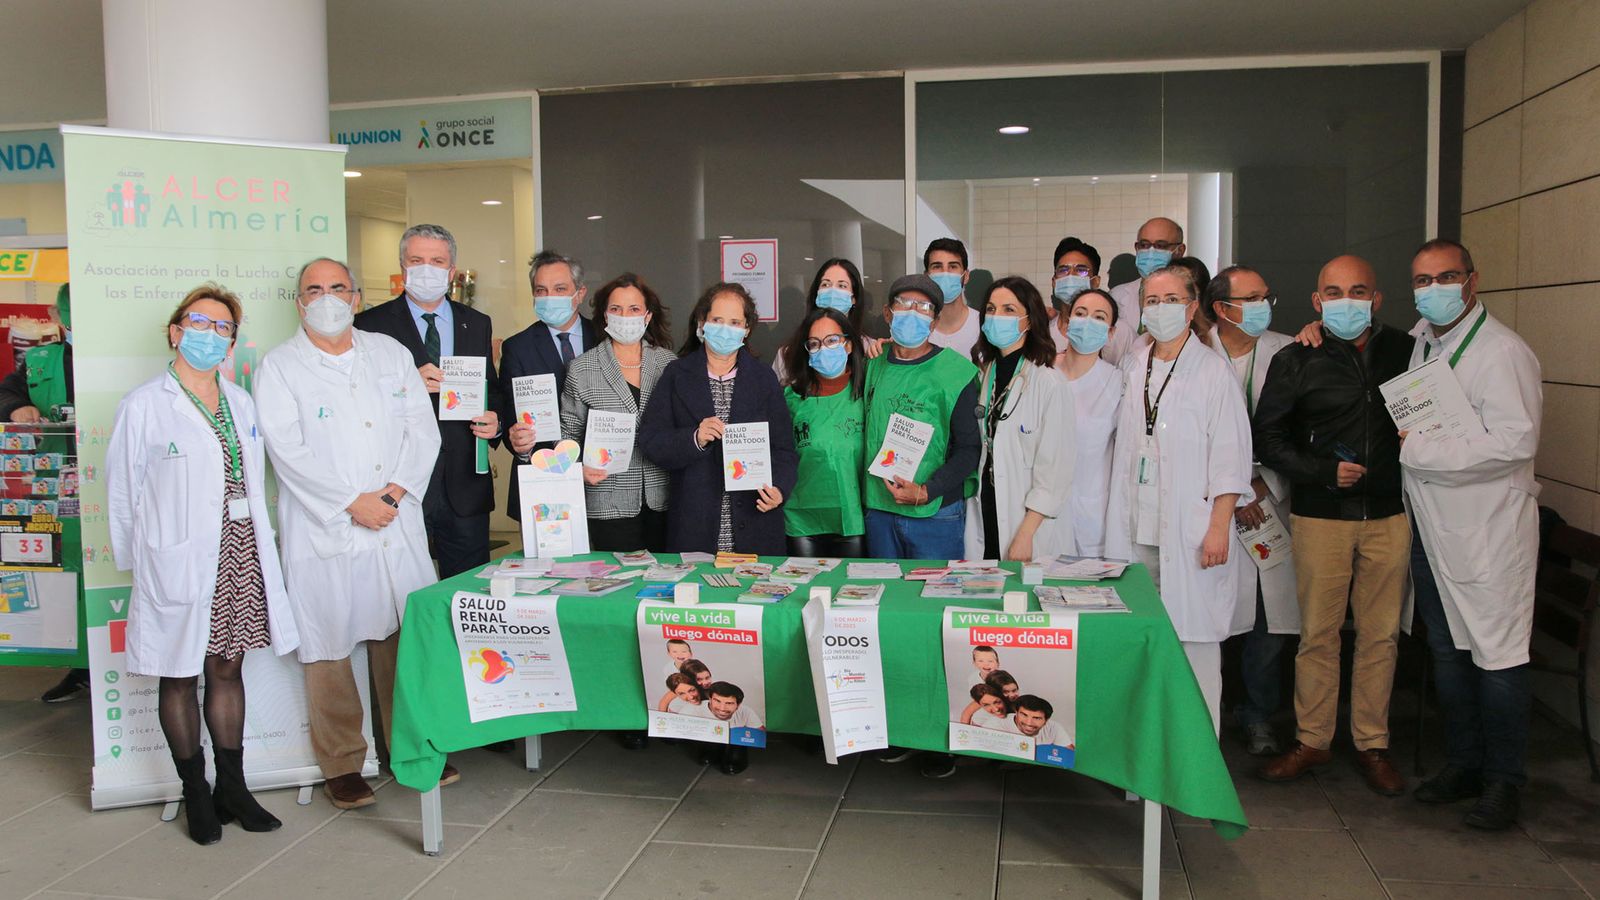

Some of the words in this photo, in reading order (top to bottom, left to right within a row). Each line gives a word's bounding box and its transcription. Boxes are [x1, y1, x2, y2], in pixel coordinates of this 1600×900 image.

[436, 121, 465, 130] grupo
[467, 117, 495, 127] social
[337, 129, 401, 145] ILUNION
[436, 129, 495, 147] ONCE
[161, 174, 290, 203] ALCER
[162, 203, 329, 234] Almería
[84, 262, 168, 277] Asociación
[174, 267, 210, 280] para
[216, 264, 229, 278] la
[235, 265, 279, 279] Lucha
[105, 285, 128, 298] las
[249, 287, 271, 300] del
[531, 388, 553, 396] TODOS
[1389, 397, 1409, 411] SALUD
[1392, 404, 1412, 417] RENAL
[1395, 410, 1411, 421] PARA
[1409, 399, 1433, 414] TODOS
[892, 422, 912, 434] RENAL
[895, 417, 915, 429] SALUD
[891, 428, 909, 440] PARA
[907, 433, 926, 446] TODOS
[459, 597, 506, 611] SALUD
[460, 611, 507, 624] RENAL
[651, 610, 680, 623] vive
[685, 610, 697, 623] la
[701, 612, 731, 625] vida
[959, 613, 990, 623] vive
[462, 623, 498, 634] PARA
[499, 625, 551, 635] TODOS
[665, 626, 703, 640] luego
[707, 628, 754, 643] dónala
[823, 635, 869, 647] ODOS
[973, 629, 1013, 645] luego
[1018, 631, 1068, 646] dónala
